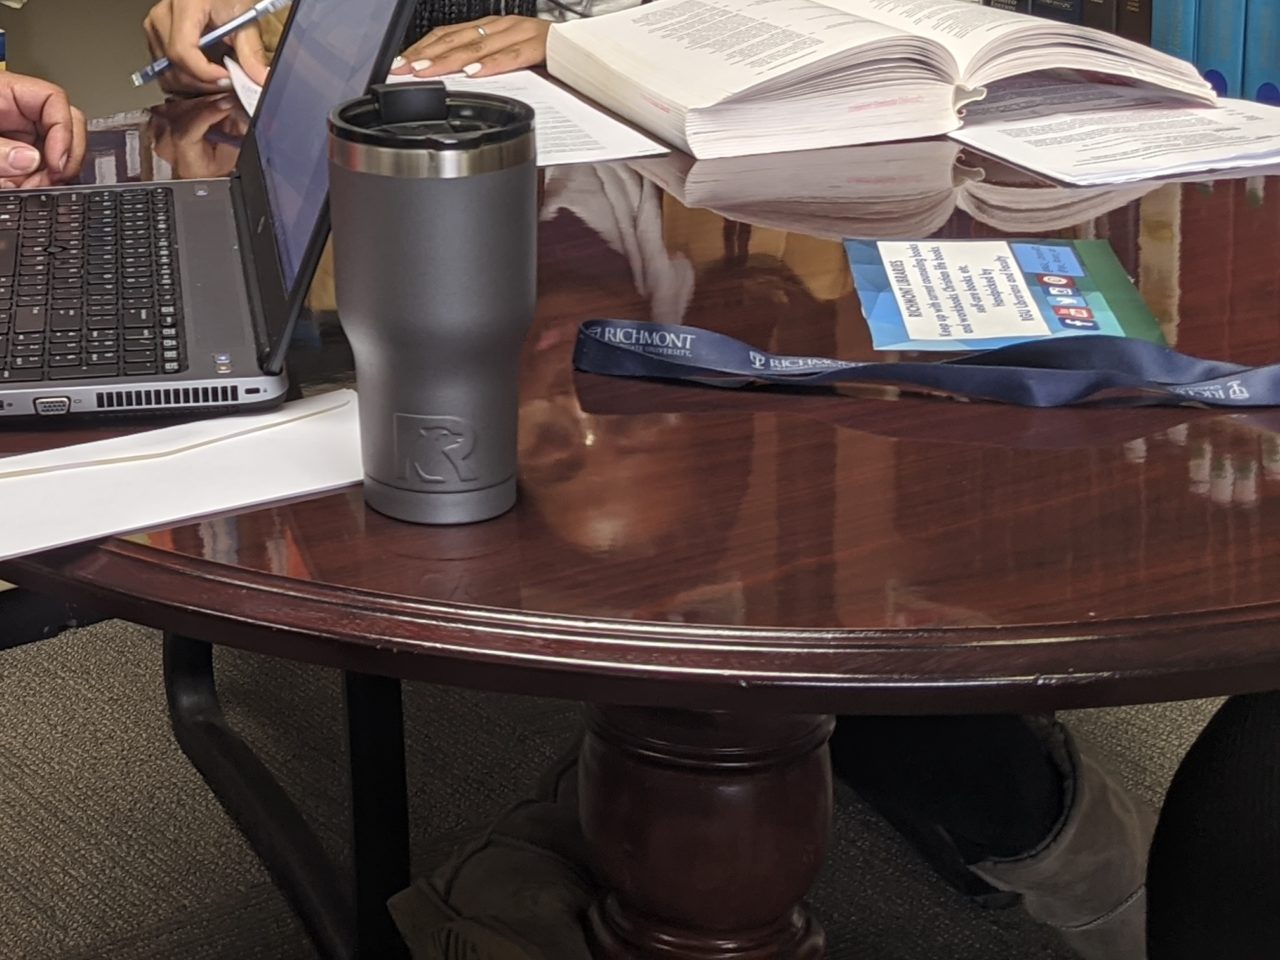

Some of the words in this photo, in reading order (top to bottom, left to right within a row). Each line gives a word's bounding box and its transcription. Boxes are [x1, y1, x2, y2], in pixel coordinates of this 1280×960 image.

[906, 243, 922, 258] books
[928, 246, 943, 261] books
[889, 259, 911, 287] LIBRARIES
[912, 258, 931, 284] counseling
[901, 287, 922, 318] RICHMONT
[984, 277, 1004, 307] Handpicked
[928, 302, 943, 314] with
[946, 293, 968, 324] workbooks
[605, 326, 697, 351] RICHMONT
[939, 323, 952, 336] Keep
